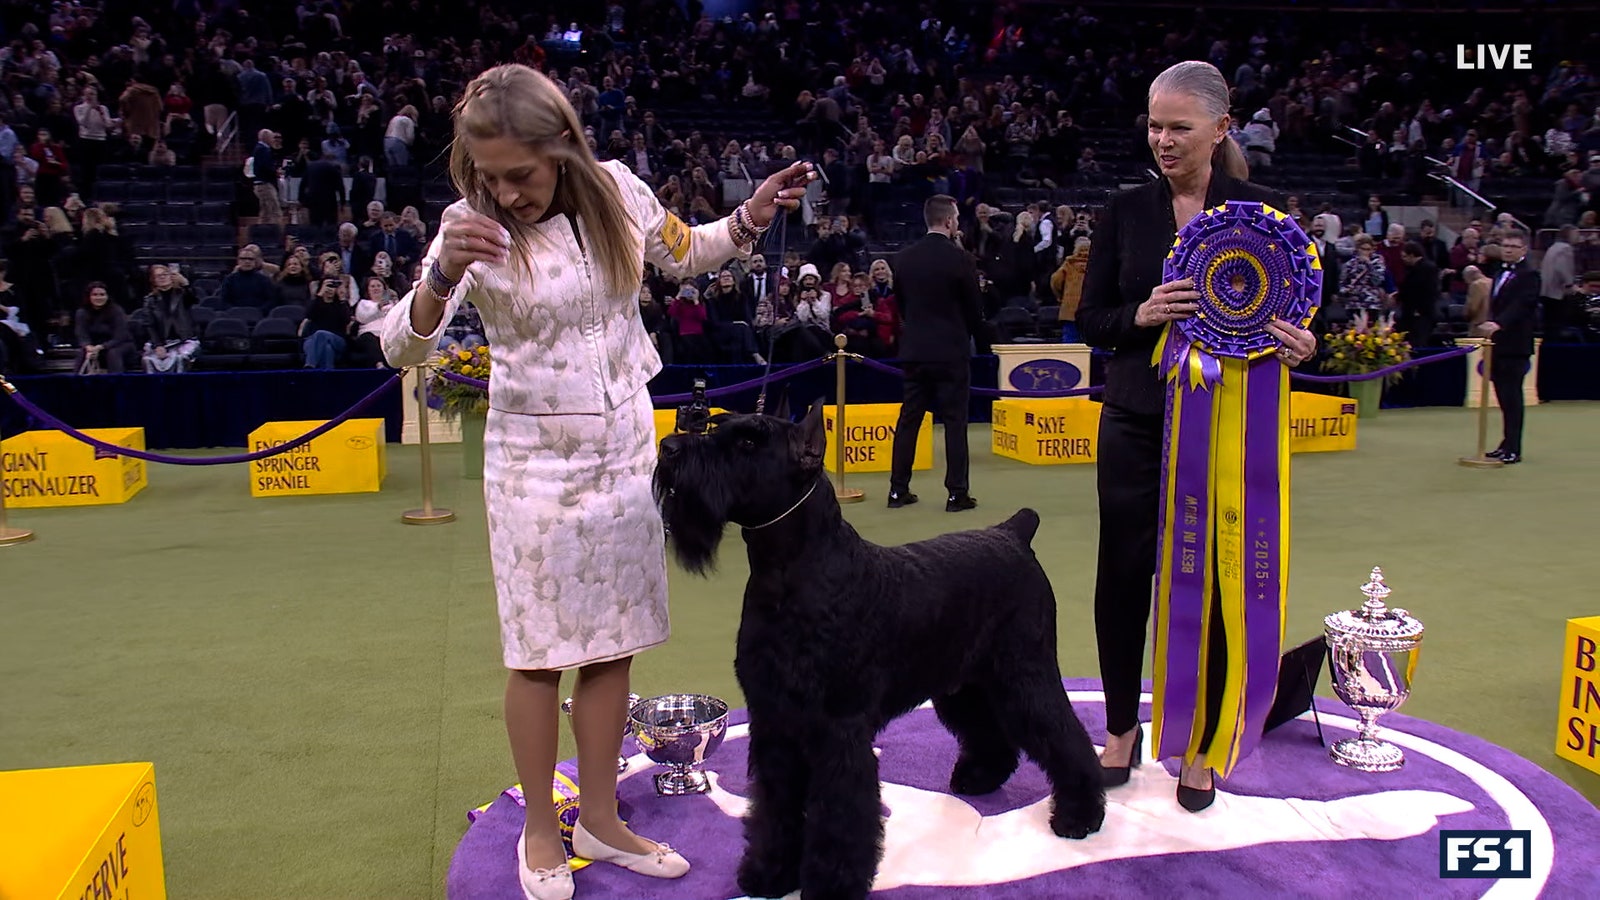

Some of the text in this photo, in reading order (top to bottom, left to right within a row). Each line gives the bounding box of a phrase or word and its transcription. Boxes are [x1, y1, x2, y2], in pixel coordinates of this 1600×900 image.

[846, 425, 897, 442] ICHON
[1037, 416, 1066, 434] SKYE
[1290, 417, 1350, 437] HIH TZU
[845, 446, 876, 464] RISE
[1036, 438, 1091, 459] TERRIER
[2, 450, 48, 472] GIANT
[256, 456, 320, 473] SPRINGER
[4, 474, 99, 498] SCHNAUZER
[258, 474, 310, 491] SPANIEL
[1181, 495, 1199, 574] BEST IN SHOW
[1255, 541, 1269, 579] 2025
